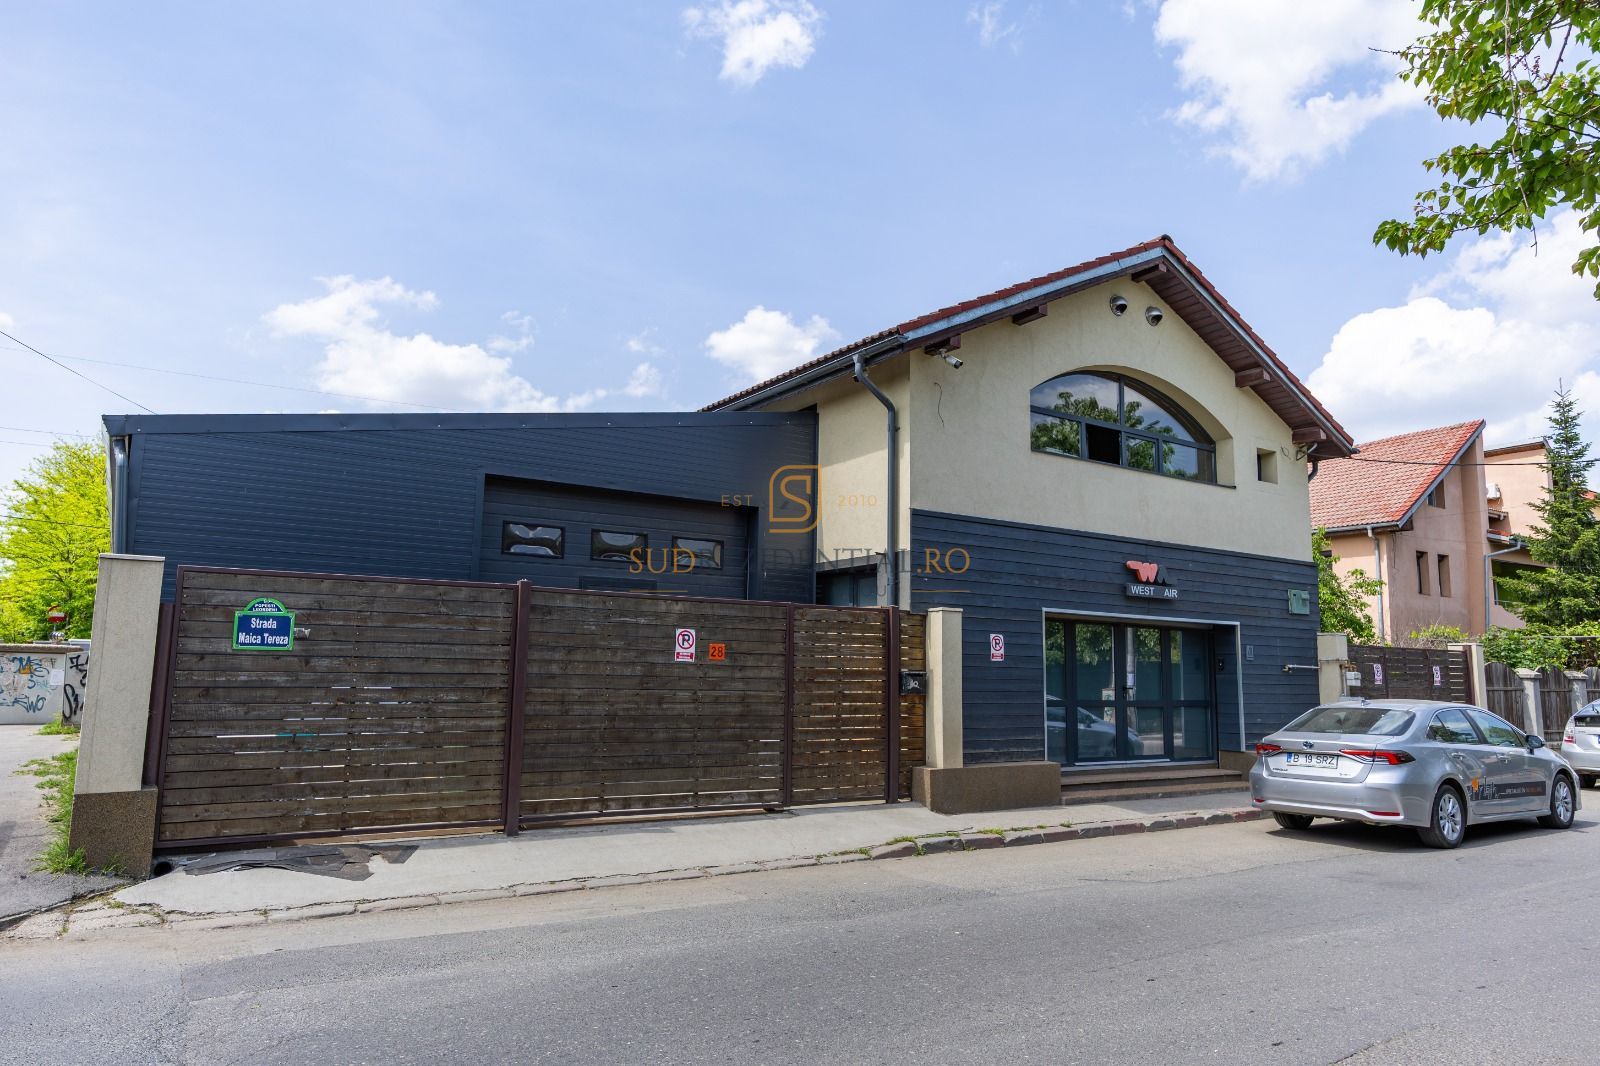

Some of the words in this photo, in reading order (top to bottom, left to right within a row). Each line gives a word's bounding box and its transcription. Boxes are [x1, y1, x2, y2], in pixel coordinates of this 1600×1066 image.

[1131, 585, 1155, 596] WEST
[1163, 588, 1178, 598] AIR
[250, 617, 277, 629] Strada
[238, 632, 262, 644] Maica
[263, 633, 289, 645] Tereza
[710, 646, 724, 658] 28
[1293, 754, 1300, 762] B
[1304, 754, 1313, 764] 19
[1315, 755, 1336, 765] SRZ
